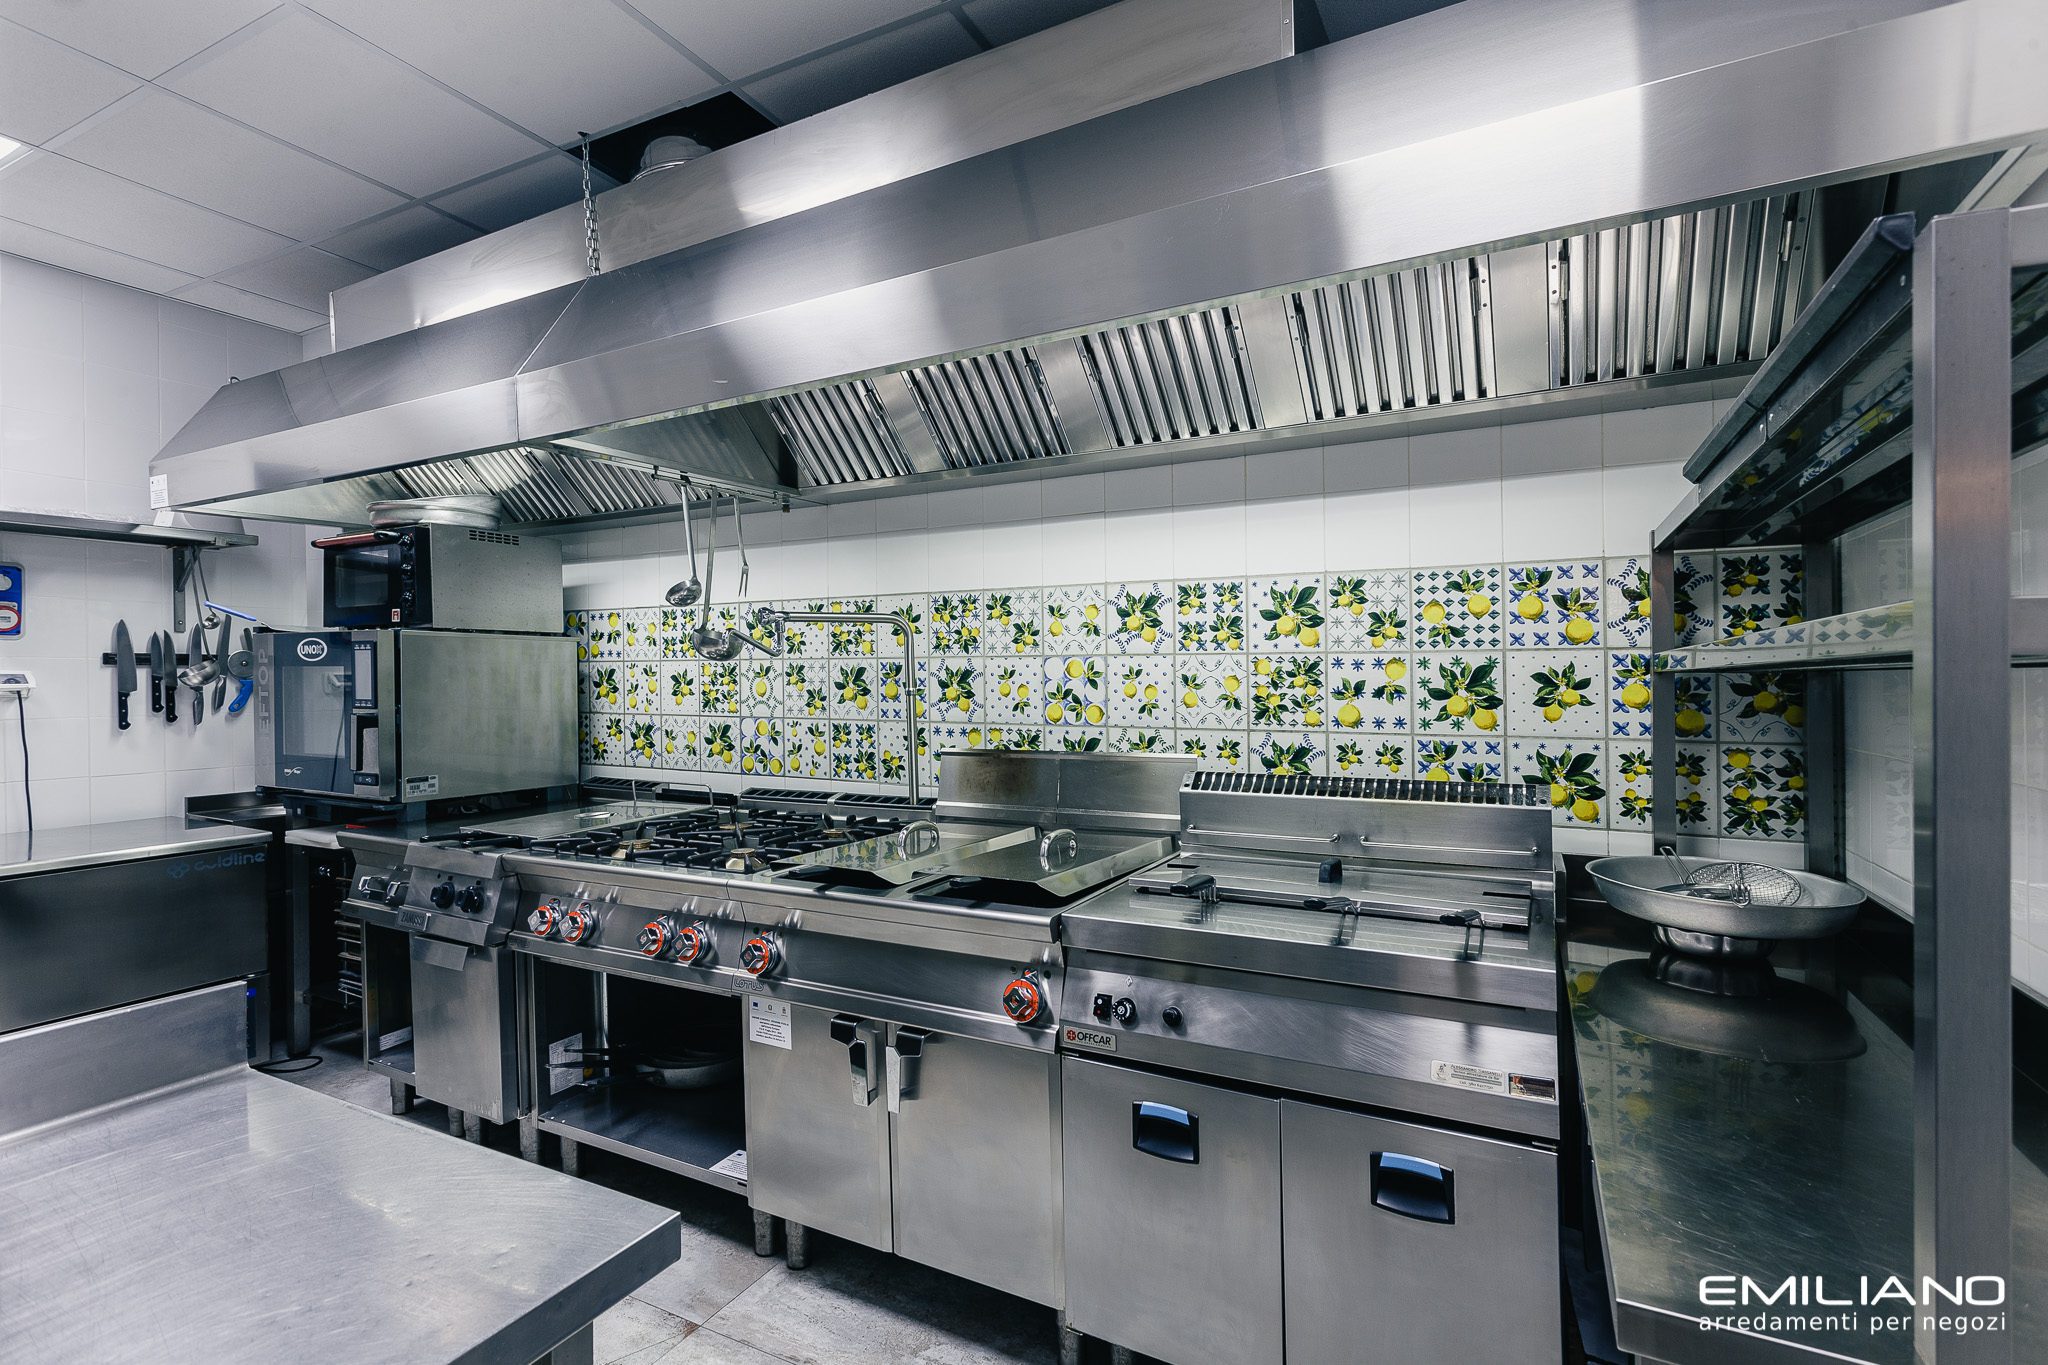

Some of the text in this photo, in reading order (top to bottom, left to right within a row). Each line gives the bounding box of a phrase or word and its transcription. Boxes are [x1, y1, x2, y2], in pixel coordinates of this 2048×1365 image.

[301, 644, 323, 655] UNOX
[258, 648, 270, 733] EFTOP
[734, 979, 765, 992] LOTUS
[1077, 1031, 1112, 1046] OFFCAR
